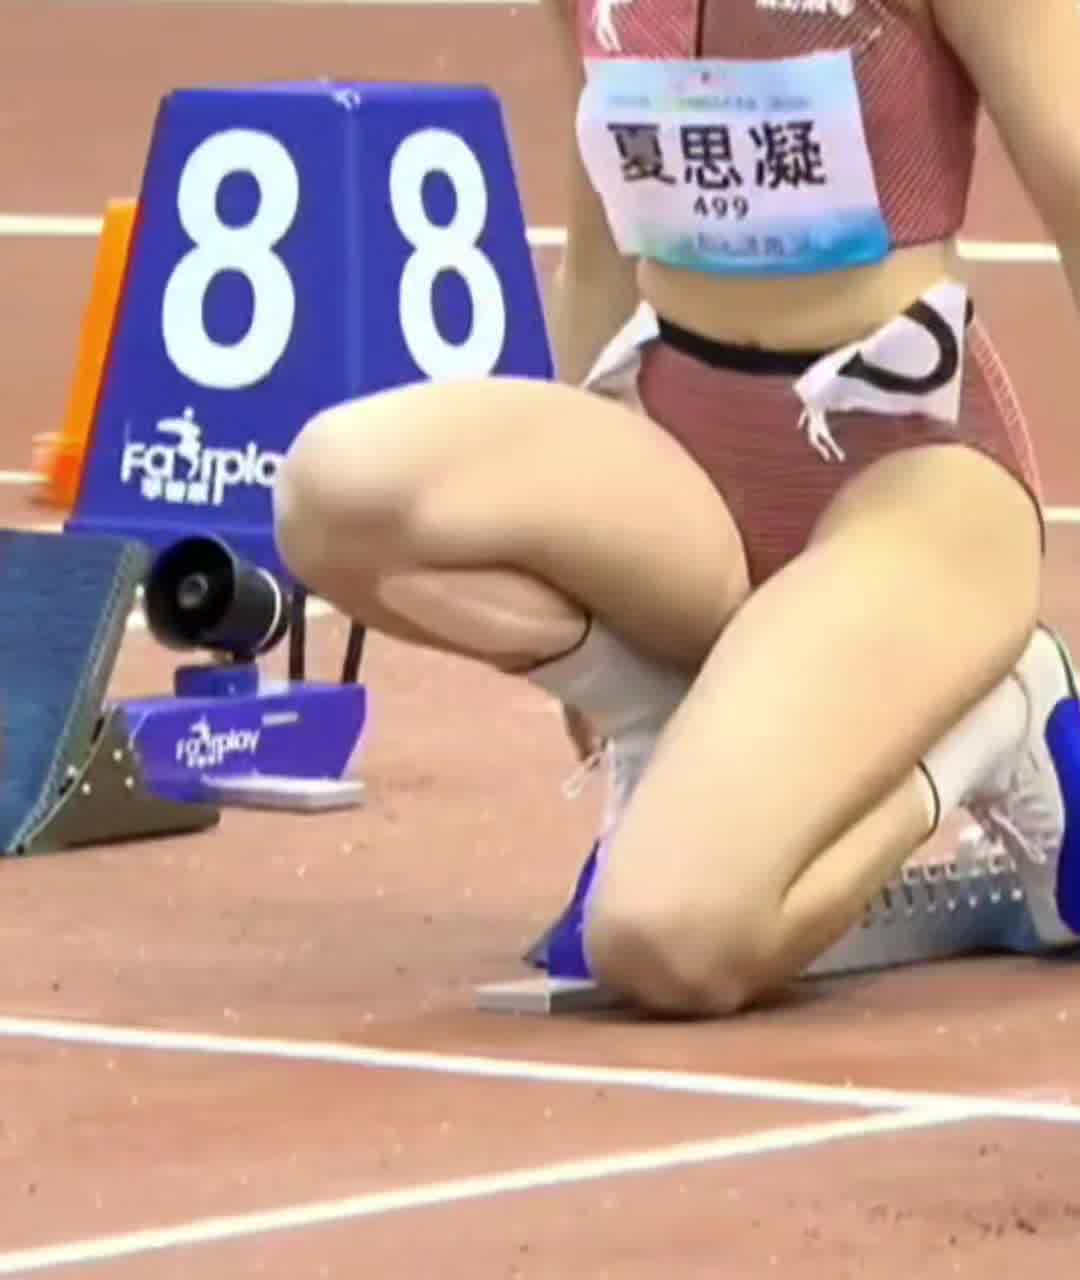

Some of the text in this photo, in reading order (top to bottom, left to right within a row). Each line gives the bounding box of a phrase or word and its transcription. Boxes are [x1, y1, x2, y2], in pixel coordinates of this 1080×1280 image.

[606, 119, 828, 190] 夏思凝
[693, 195, 750, 218] 499
[160, 128, 299, 389] 8
[389, 128, 508, 380] 8
